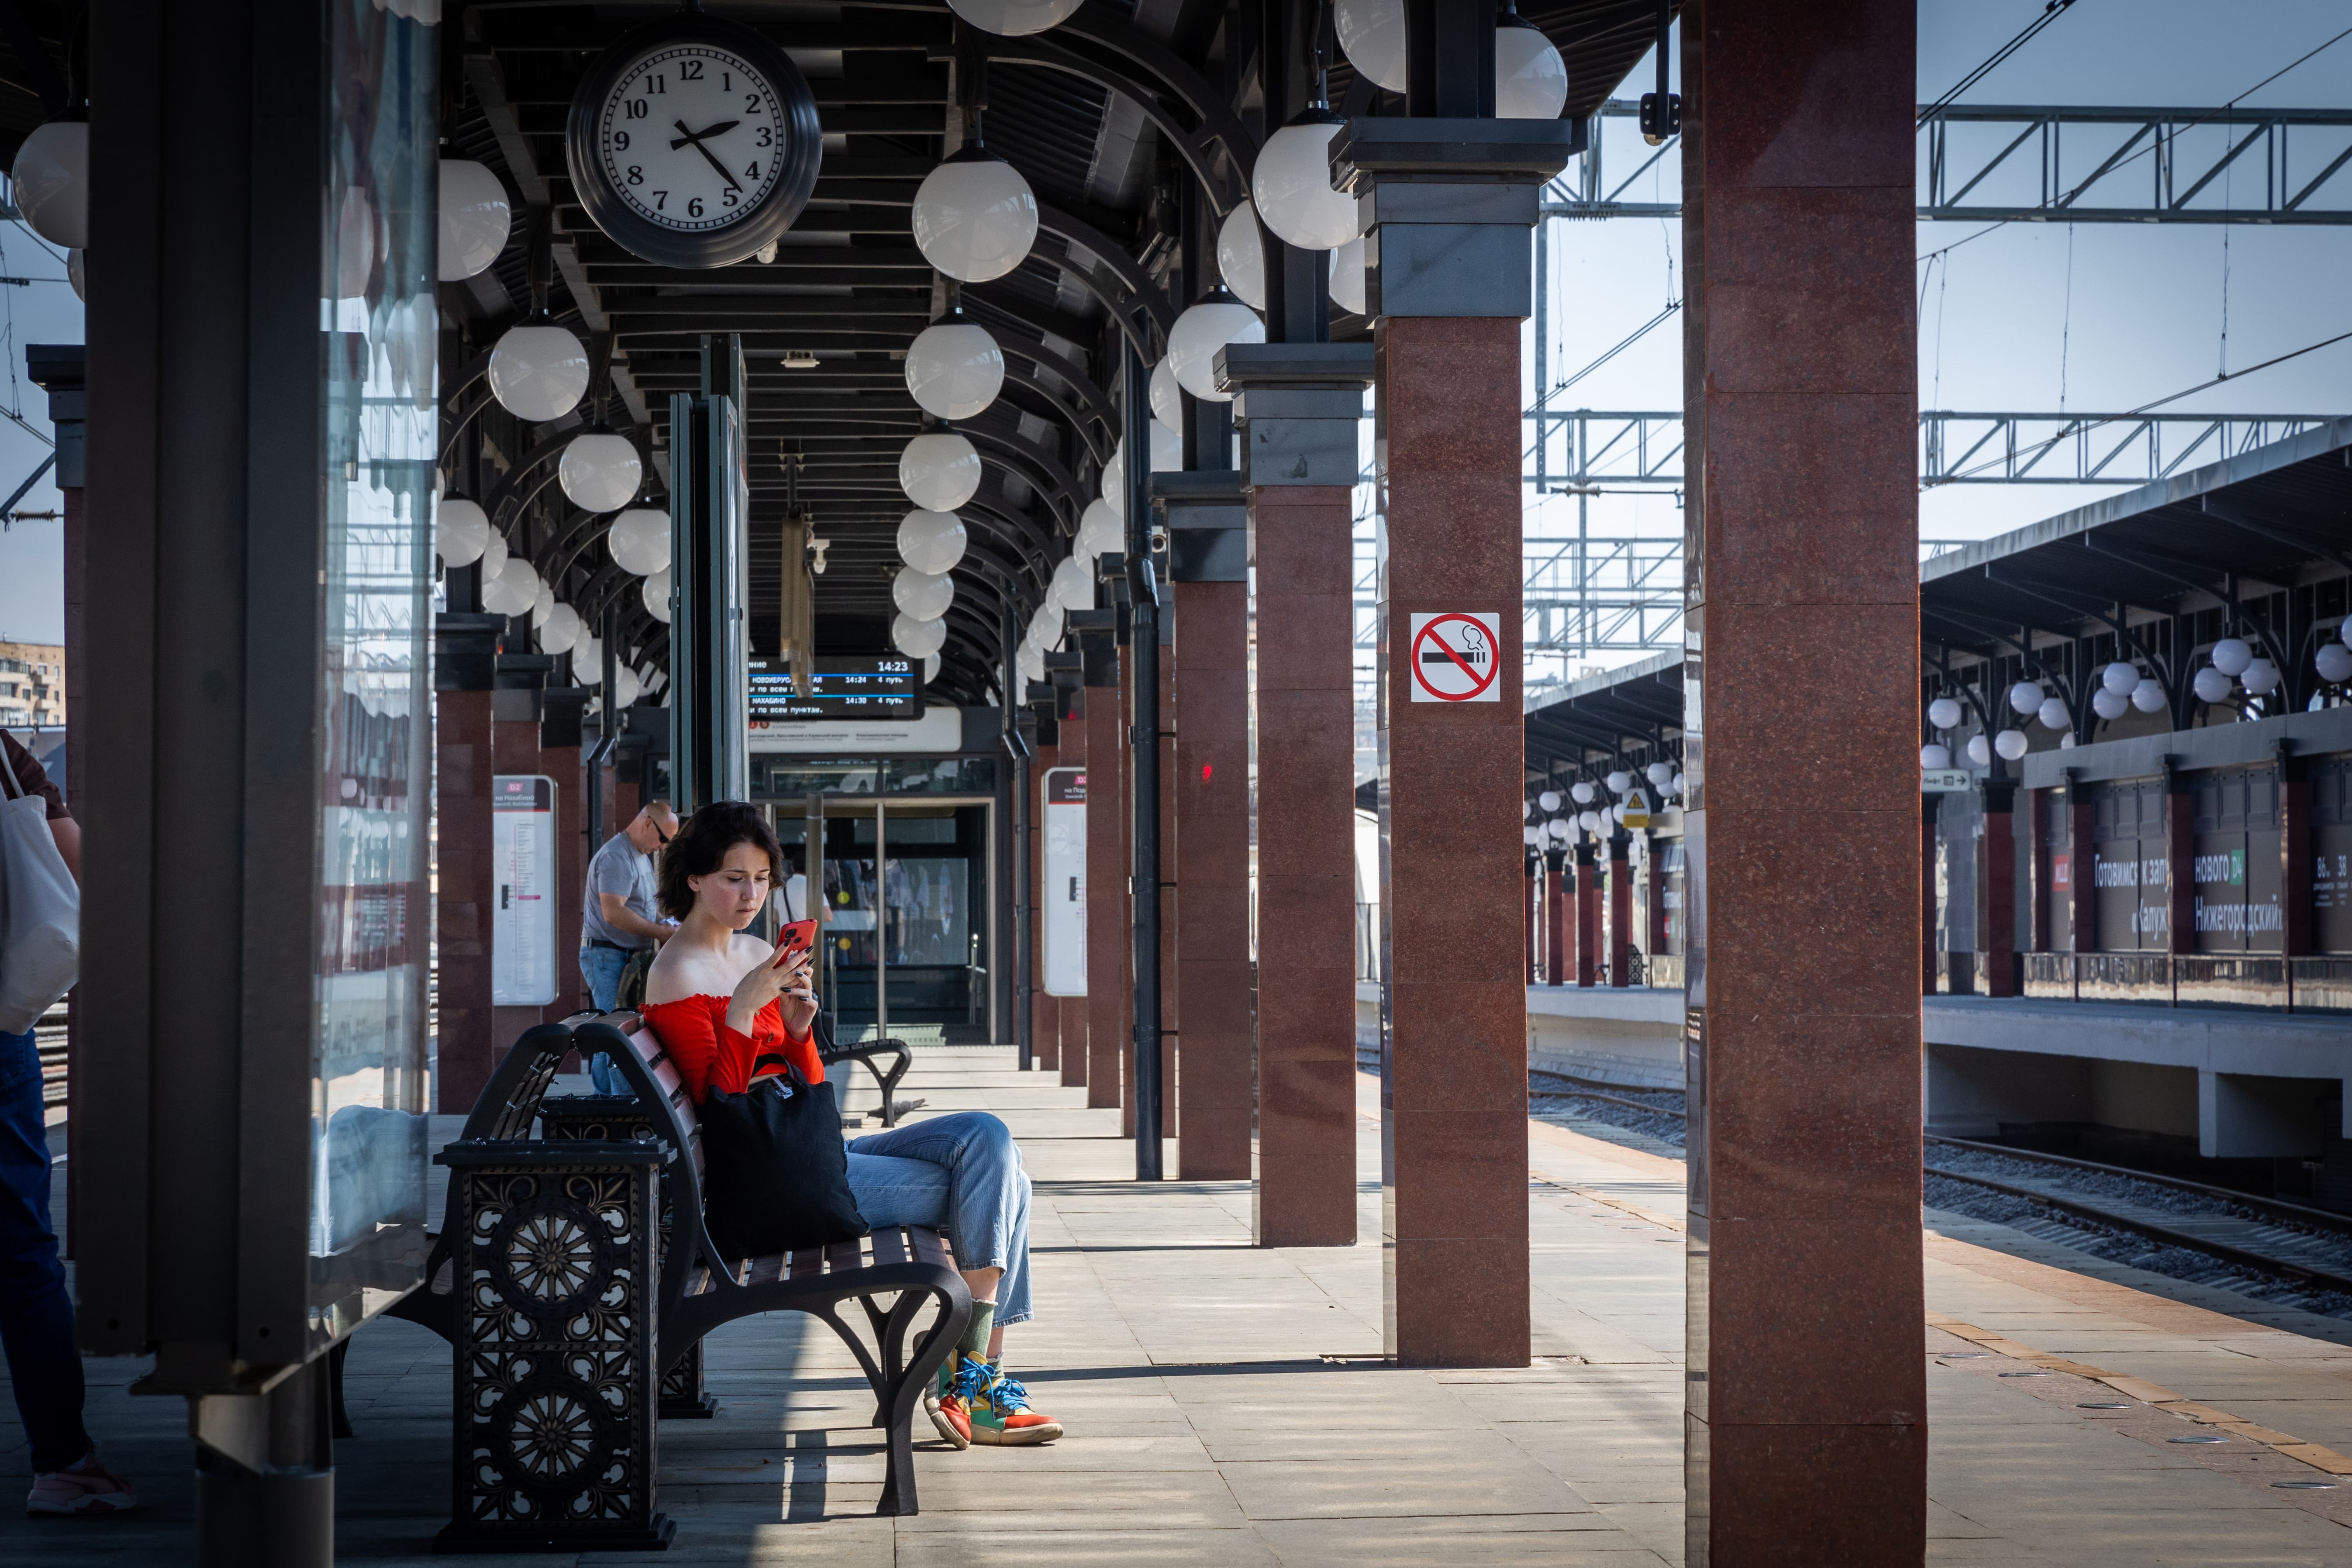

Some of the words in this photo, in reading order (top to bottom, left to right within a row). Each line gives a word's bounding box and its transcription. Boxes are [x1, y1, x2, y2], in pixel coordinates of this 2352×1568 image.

[679, 60, 704, 80] 12
[646, 75, 666, 94] 11
[722, 73, 731, 91] 1
[625, 99, 648, 119] 10
[745, 94, 761, 114] 2
[614, 131, 629, 151] 9
[756, 127, 772, 146] 3
[628, 166, 644, 185] 8
[745, 161, 760, 180] 4
[653, 191, 668, 210] 7
[723, 187, 738, 206] 5
[688, 198, 704, 217] 6
[878, 661, 908, 672] 14:23
[2095, 853, 2138, 888] Готовимся
[2142, 859, 2147, 885] к
[2195, 854, 2229, 882] нового
[2231, 855, 2243, 879] D4
[2338, 855, 2347, 877] 38
